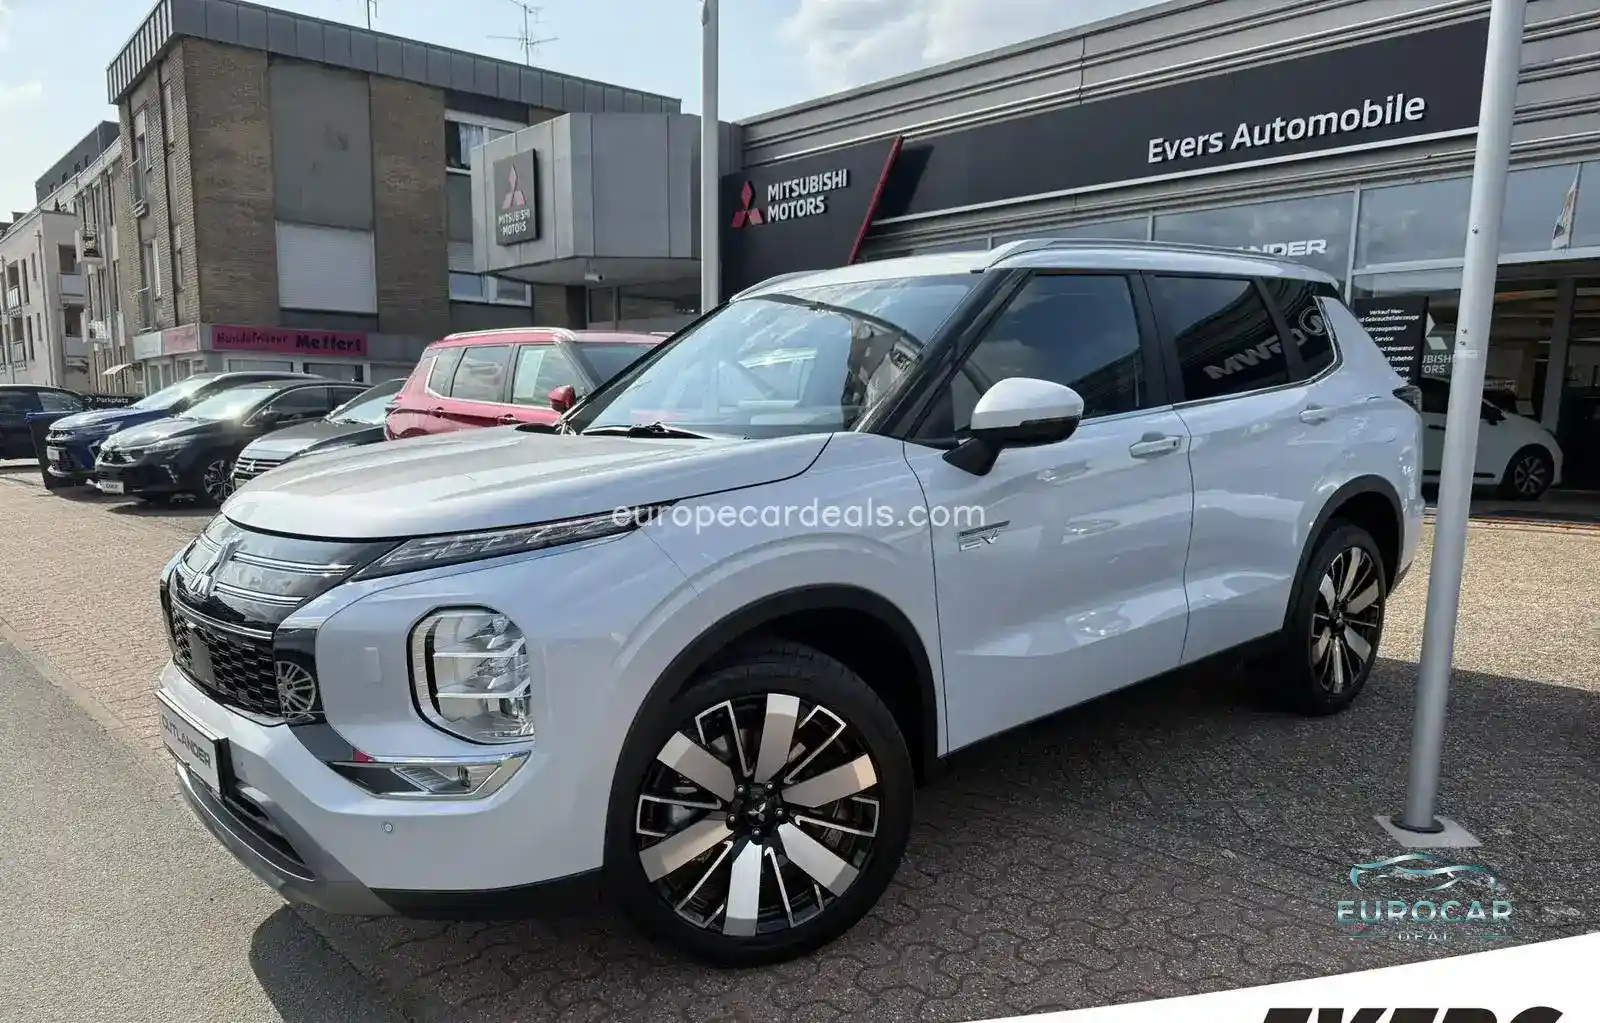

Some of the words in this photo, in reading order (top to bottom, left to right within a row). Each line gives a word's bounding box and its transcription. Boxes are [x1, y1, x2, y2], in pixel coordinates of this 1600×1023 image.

[1147, 131, 1224, 163] Evers
[1229, 93, 1426, 151] Automobile
[767, 168, 848, 203] MITSUBISHI
[767, 195, 826, 224] MOTORS
[502, 221, 527, 237] MOTORS
